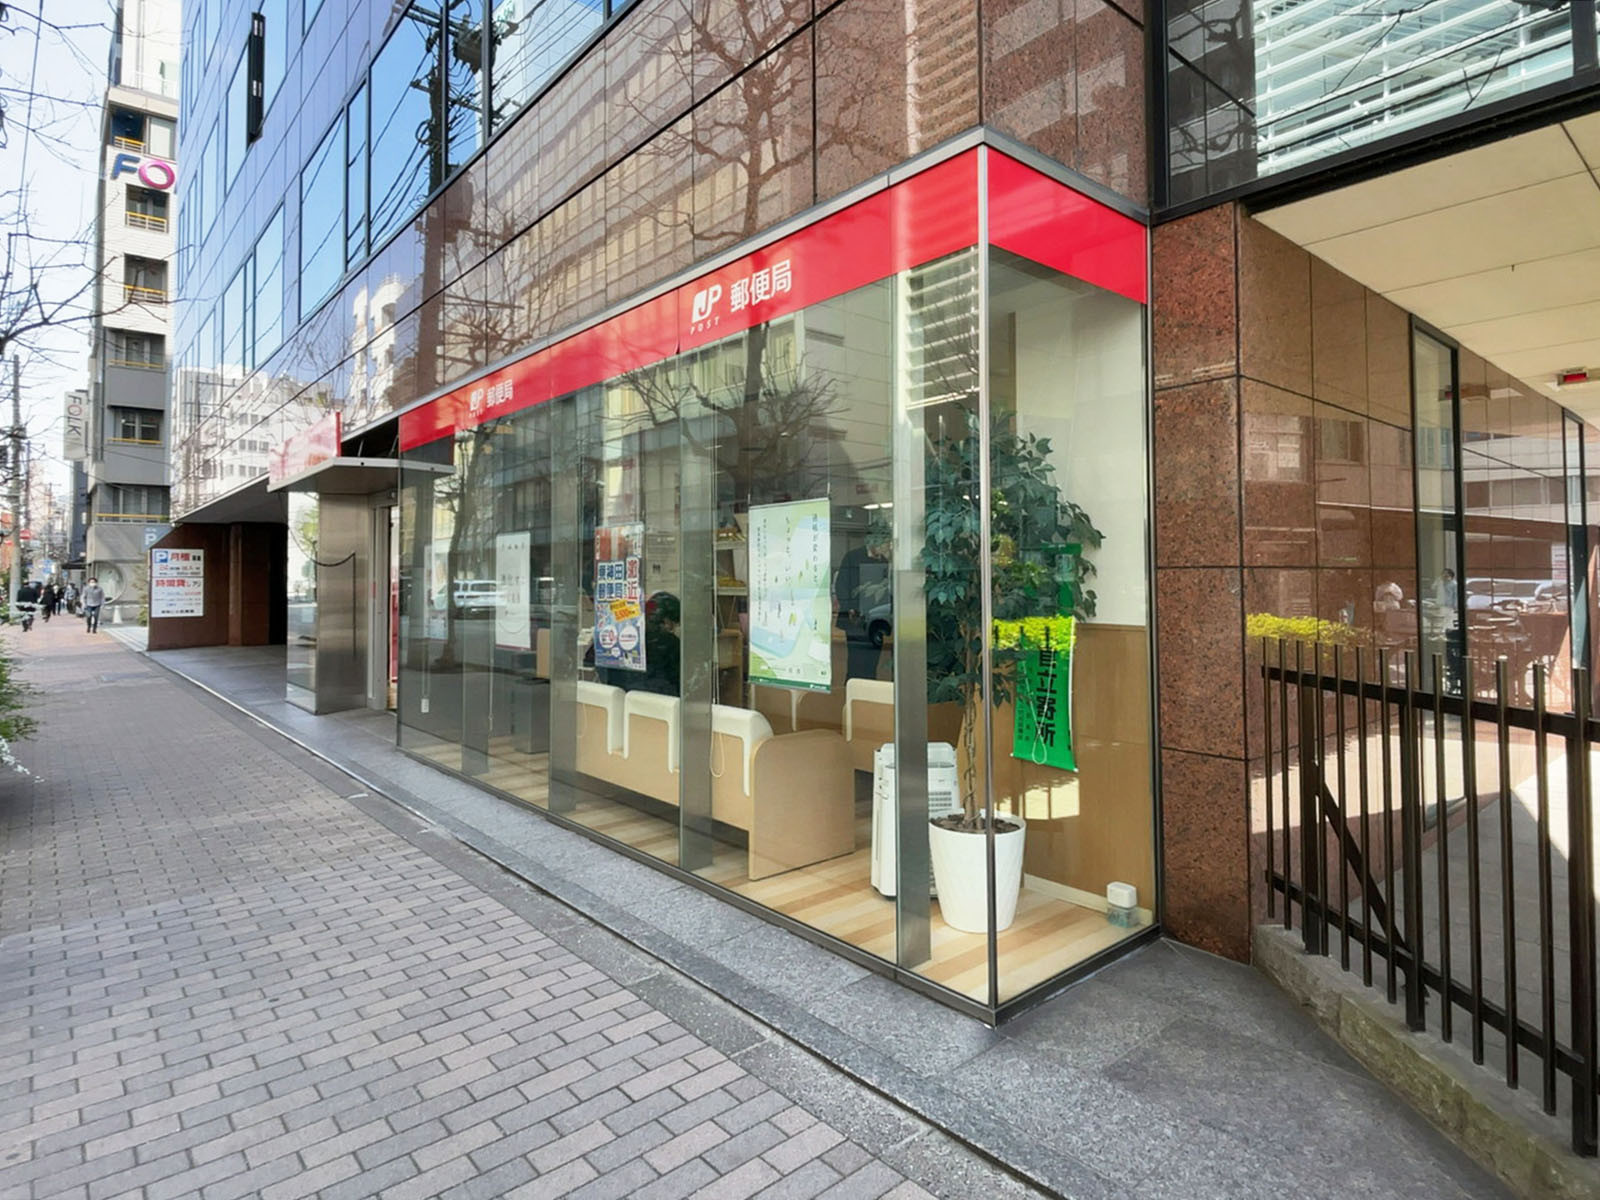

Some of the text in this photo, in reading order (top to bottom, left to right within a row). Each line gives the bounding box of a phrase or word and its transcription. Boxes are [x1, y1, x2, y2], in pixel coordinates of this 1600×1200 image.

[111, 152, 176, 190] FO
[730, 259, 792, 313] 郵便局
[689, 316, 720, 335] POST
[486, 379, 513, 408] 郵便局
[67, 394, 83, 437] FOLK
